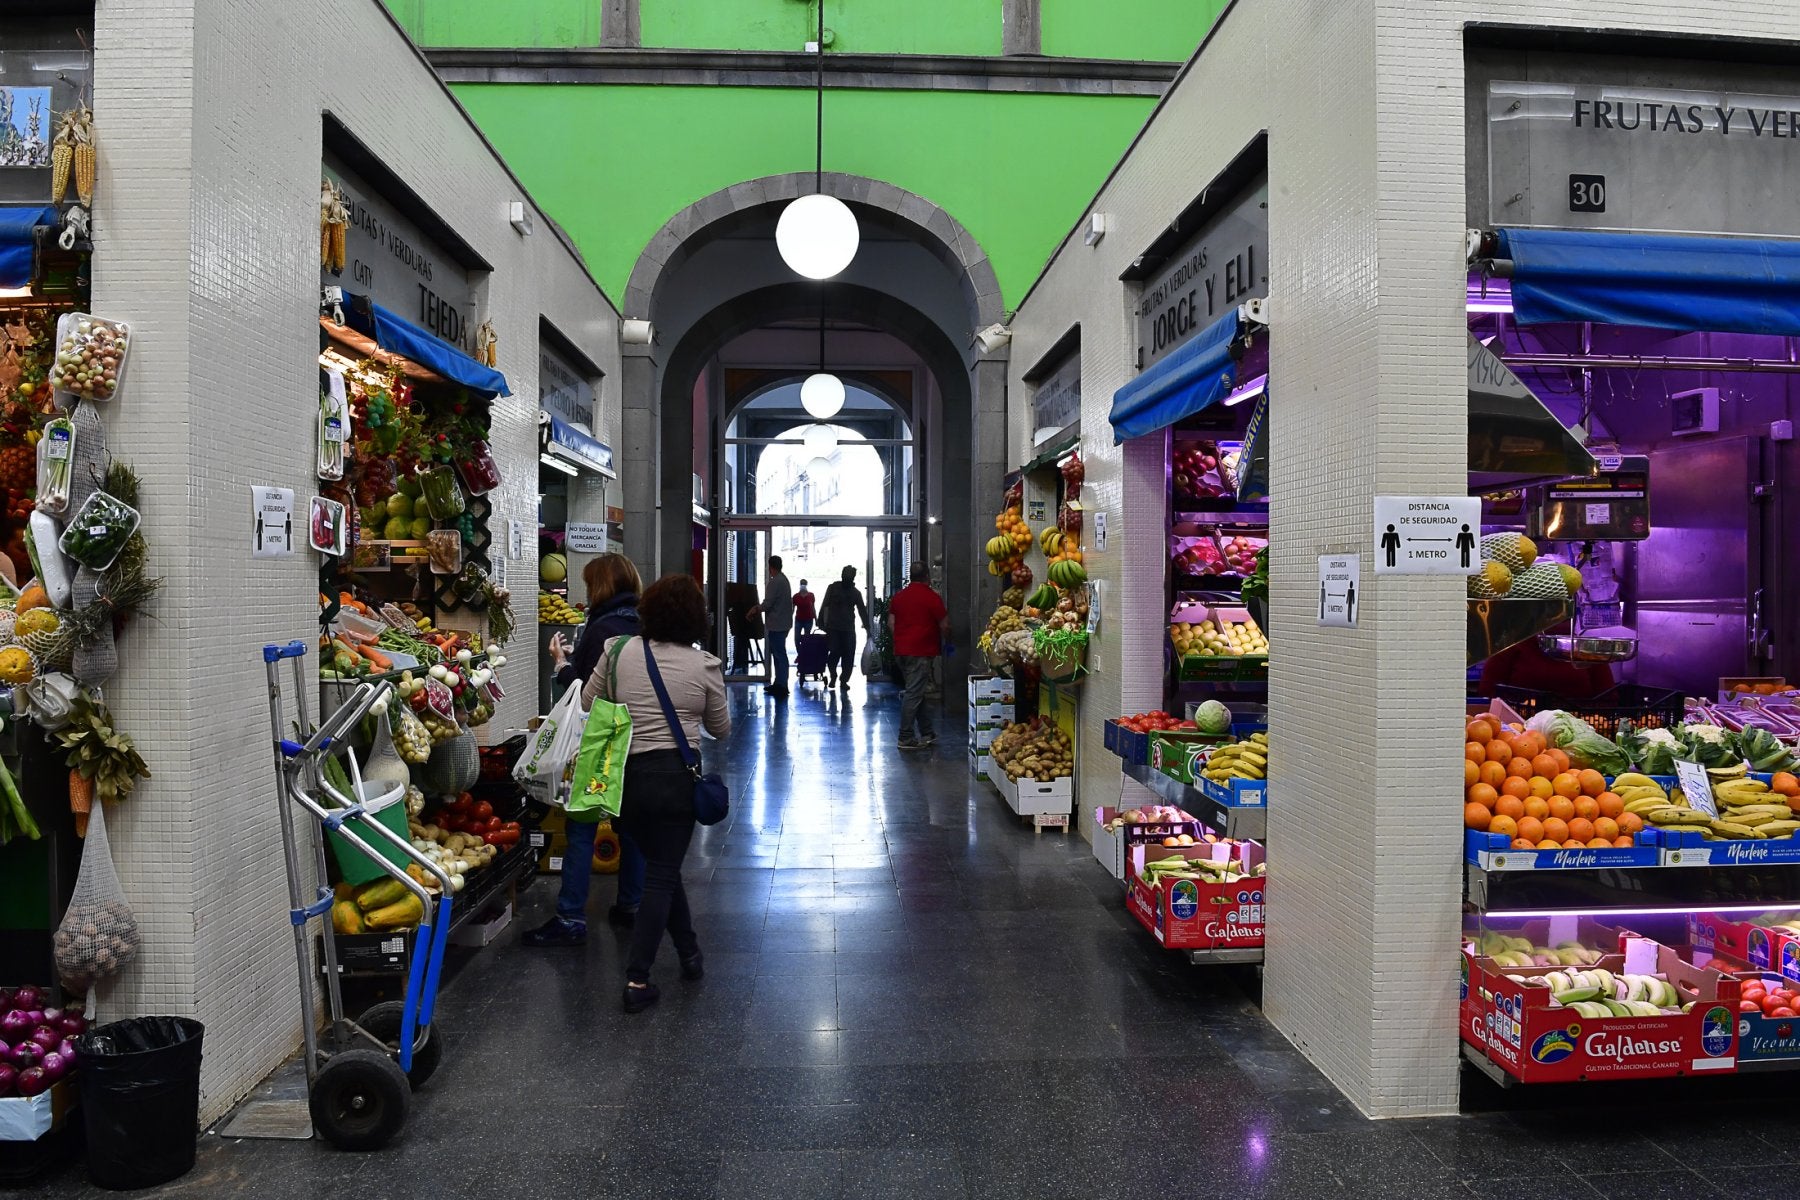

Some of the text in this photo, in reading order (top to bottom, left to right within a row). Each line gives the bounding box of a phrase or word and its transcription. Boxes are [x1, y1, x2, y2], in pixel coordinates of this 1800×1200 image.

[1575, 100, 1703, 133] FRUTAS
[1715, 107, 1735, 135] Y
[1573, 182, 1604, 205] 30
[380, 224, 386, 246] Y
[388, 231, 433, 281] VERDURAS
[354, 259, 373, 290] CATY
[1142, 247, 1207, 319] FRUTAS Y VERDURAS
[1152, 245, 1254, 355] JORGE Y ELI
[418, 282, 468, 350] TEJEDA
[1243, 393, 1267, 459] CHAVILLO
[1408, 503, 1450, 511] DISTANCIA
[1412, 517, 1457, 525] SEGURIDAD
[1416, 550, 1447, 558] METRO
[1553, 850, 1596, 868] Marlene
[1728, 843, 1768, 864] Marlene
[1585, 1033, 1681, 1063] Galdense
[1752, 1036, 1800, 1052] Yeowa
